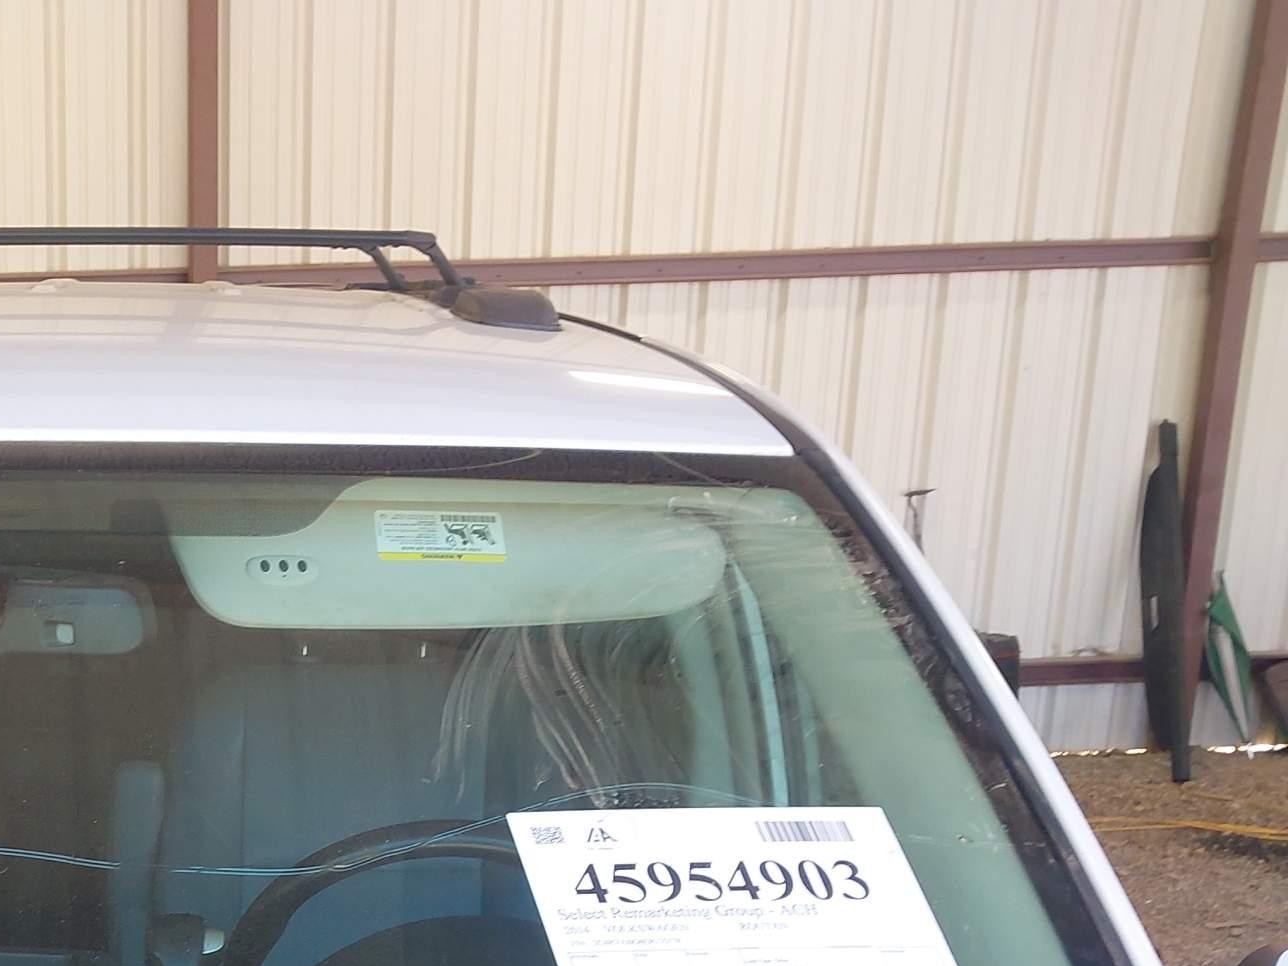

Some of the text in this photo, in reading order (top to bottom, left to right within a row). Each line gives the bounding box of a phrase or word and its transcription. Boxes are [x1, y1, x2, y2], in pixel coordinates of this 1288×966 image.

[574, 859, 870, 903] 45954903
[557, 907, 608, 921] Select
[610, 905, 712, 921] Remarketing
[714, 904, 764, 919] Group
